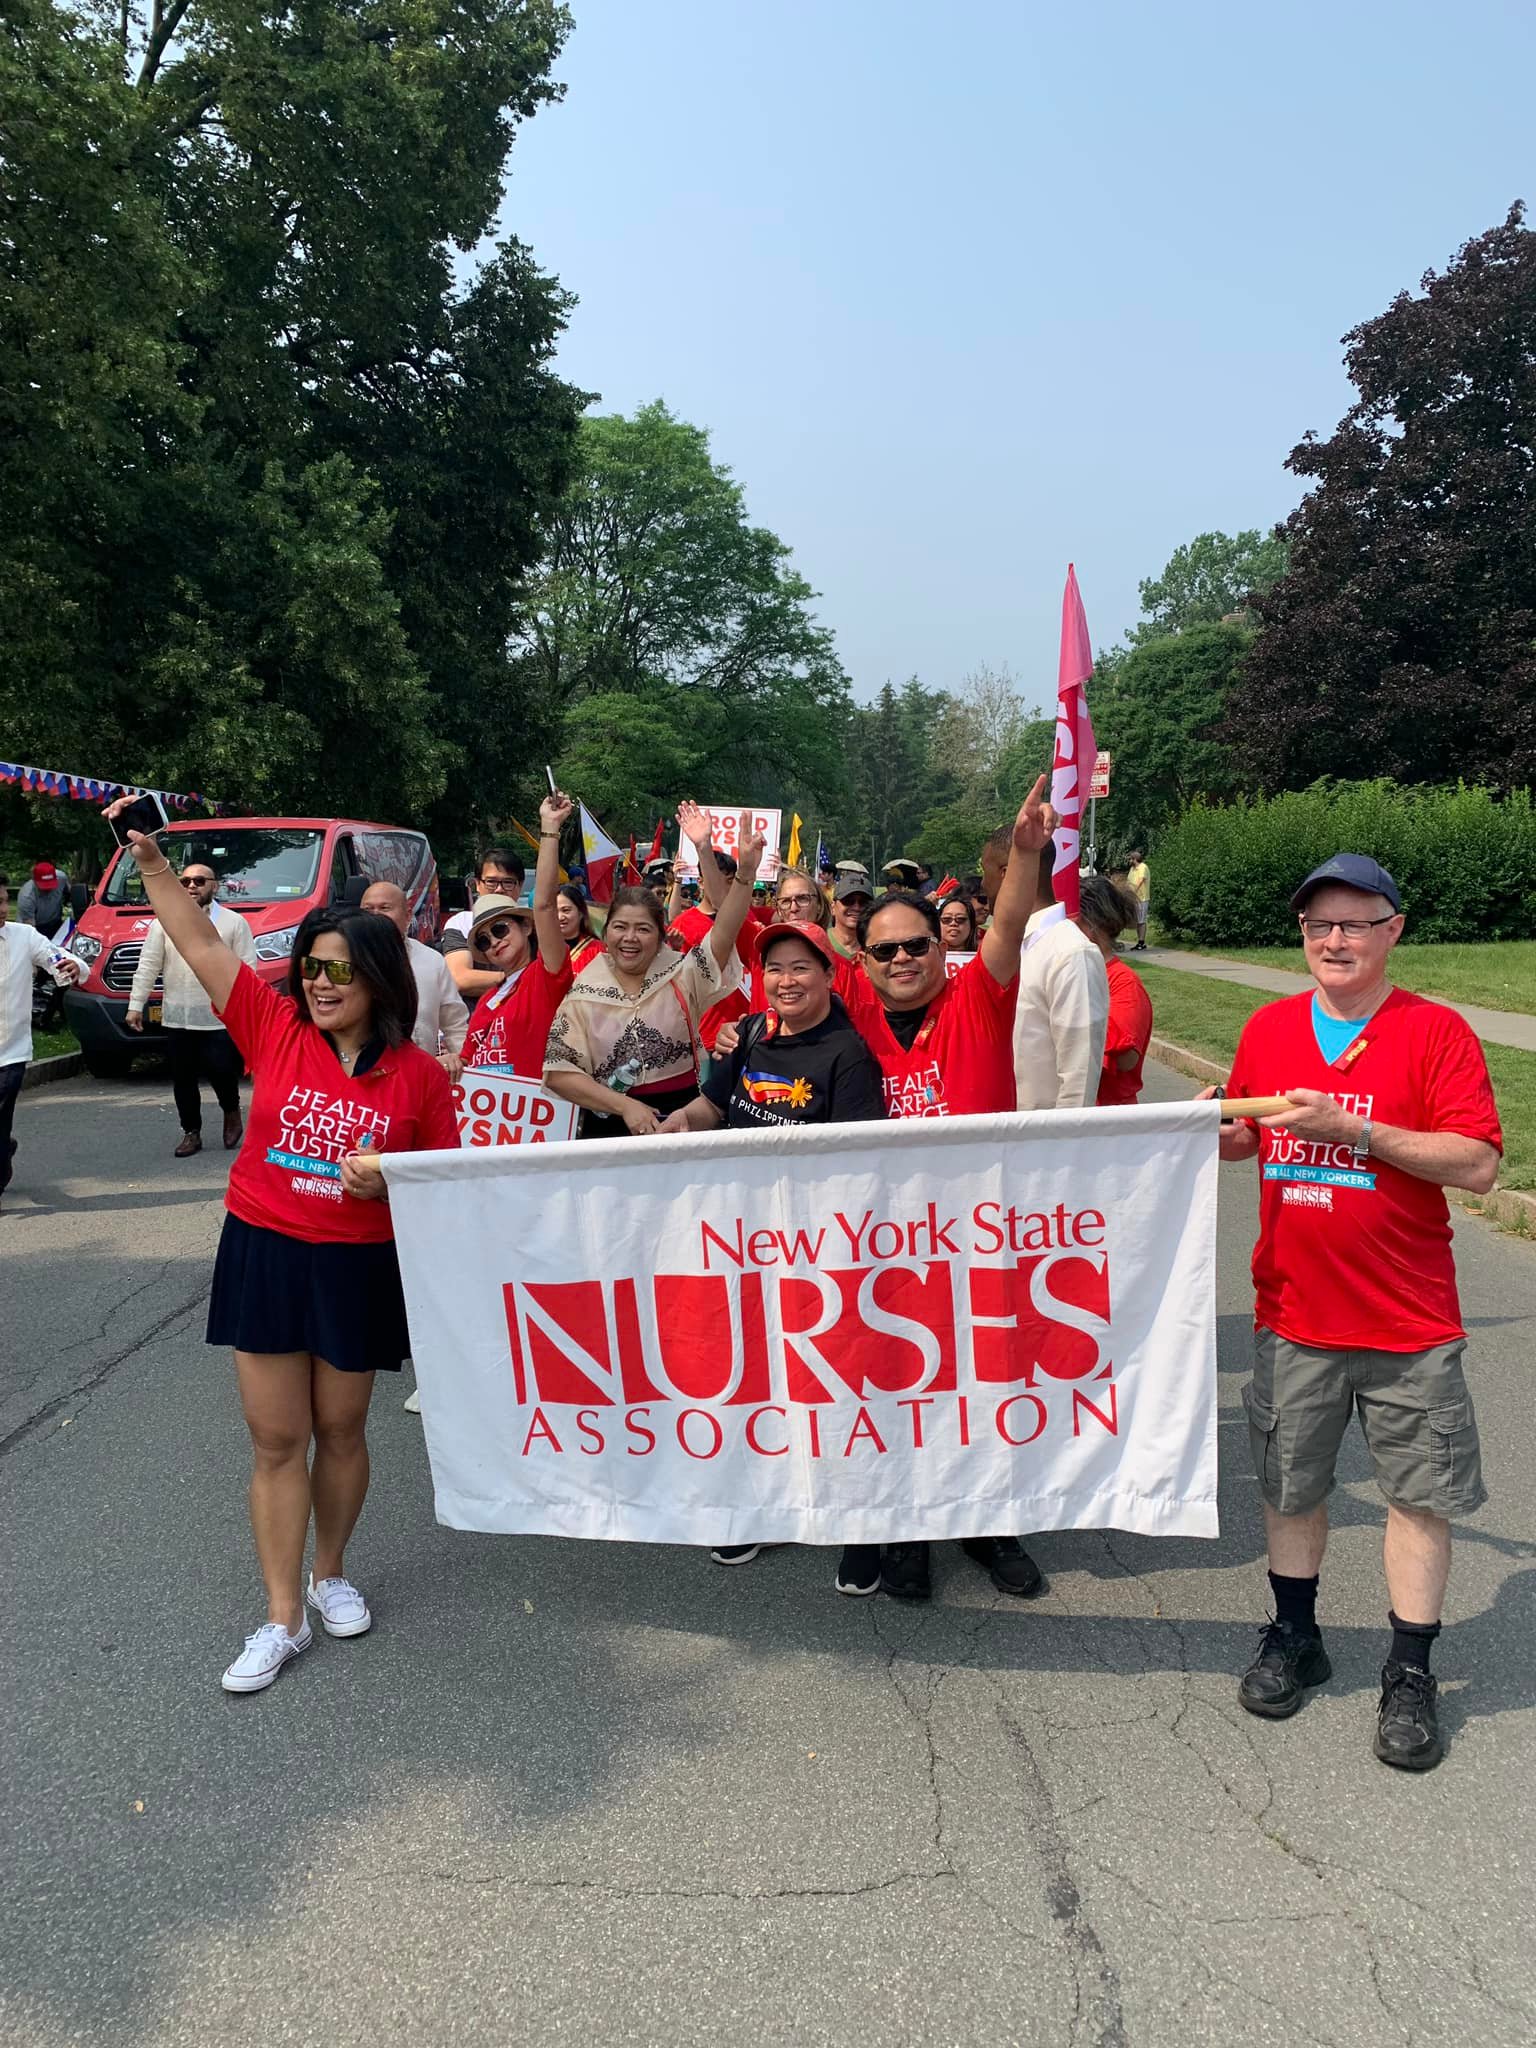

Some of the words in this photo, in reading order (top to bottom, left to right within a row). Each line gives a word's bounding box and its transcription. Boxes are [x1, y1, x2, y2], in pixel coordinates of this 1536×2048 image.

[279, 1105, 352, 1143] CARE
[287, 1085, 391, 1135] HEALTH
[451, 1084, 555, 1126] ROUD
[270, 1152, 286, 1165] FOR
[288, 1158, 305, 1169] ALL
[308, 1163, 331, 1174] NEW
[1279, 1167, 1291, 1178] ALL
[1294, 1169, 1317, 1179] NEW
[1320, 1171, 1371, 1187] YORKERS
[700, 1218, 826, 1270] New
[834, 1202, 961, 1263] York
[973, 1201, 1107, 1255] State
[502, 1251, 1113, 1407] NURSES
[521, 1383, 1119, 1459] ASSOCIATION
